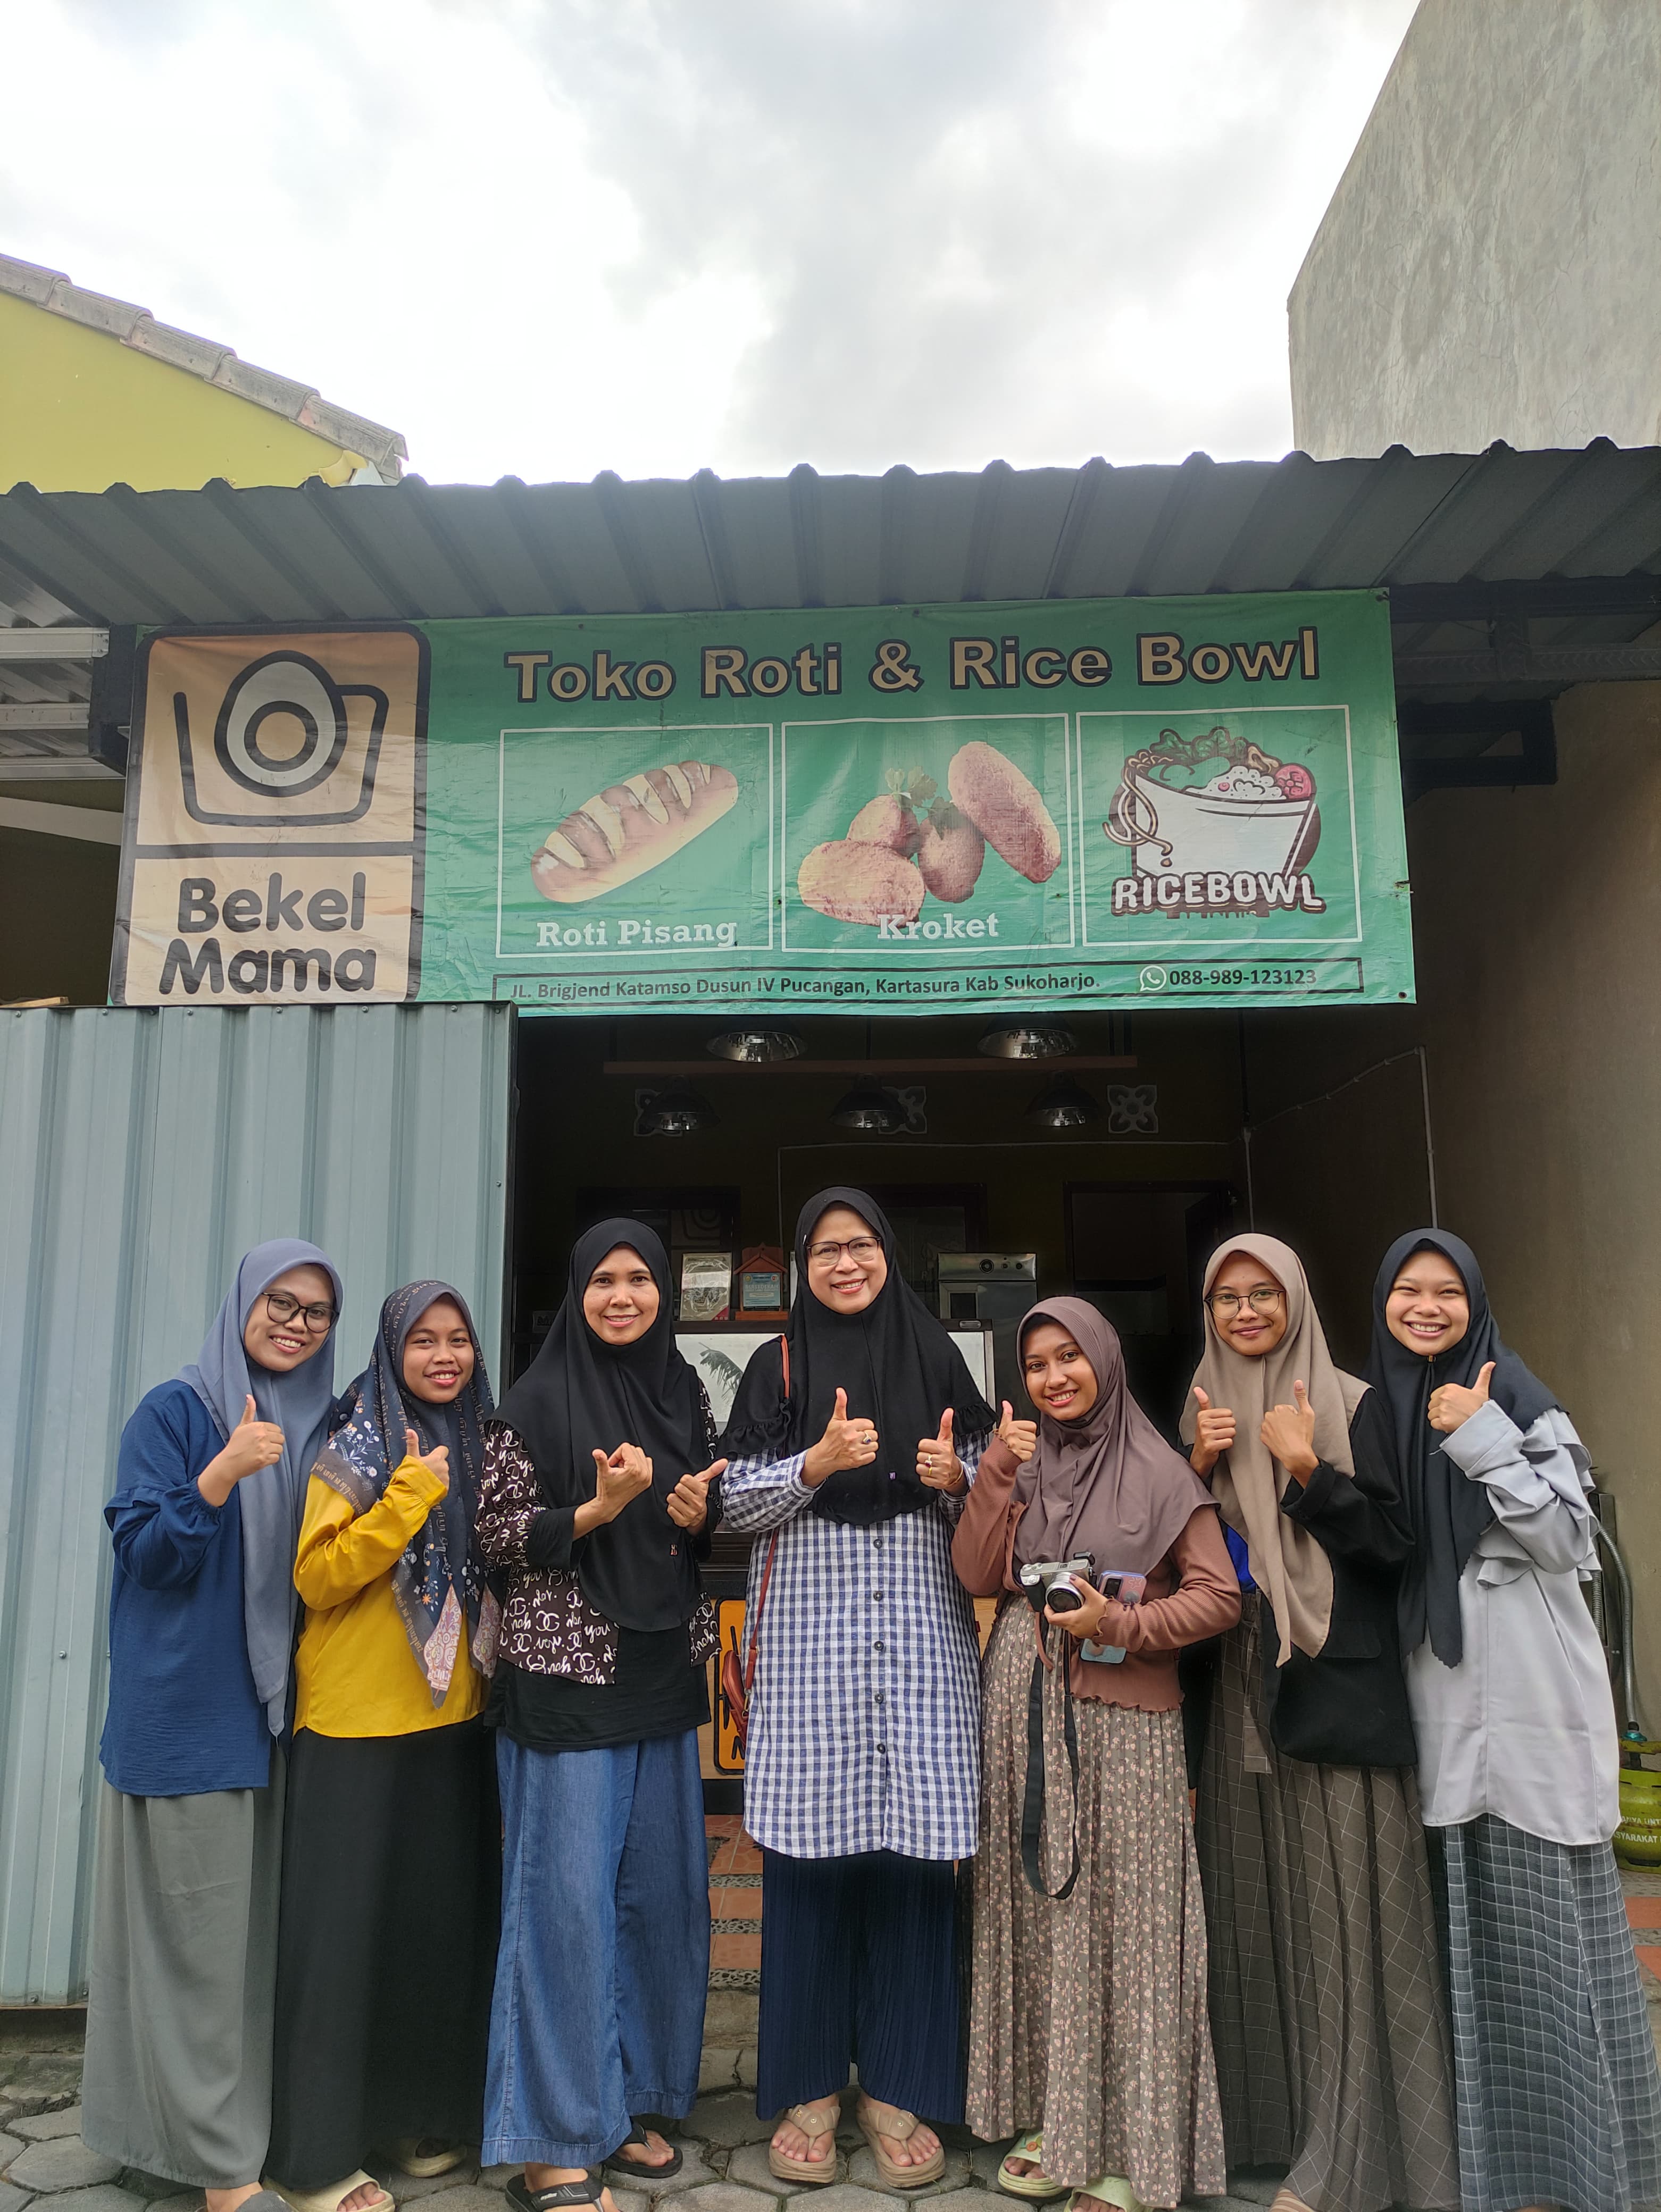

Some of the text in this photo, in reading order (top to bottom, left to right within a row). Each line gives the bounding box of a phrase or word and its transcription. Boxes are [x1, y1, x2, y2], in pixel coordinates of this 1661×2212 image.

[504, 626, 1320, 702] Toko Roti & Rice Bowl
[178, 872, 366, 933] Bekel
[1114, 870, 1323, 910] RICEBOWL
[536, 919, 737, 948] Roti Pisang
[877, 912, 999, 940] Kroket
[158, 937, 377, 995] Mama
[1169, 969, 1317, 985] 088-989-123123
[511, 973, 1100, 1000] JL. Brigjend Katamso Dusun IV Pucangan, Kartasura Kab Sukoharjo.
[585, 1623, 611, 1644] you
[1614, 1831, 1658, 1844] SYARAKAT
